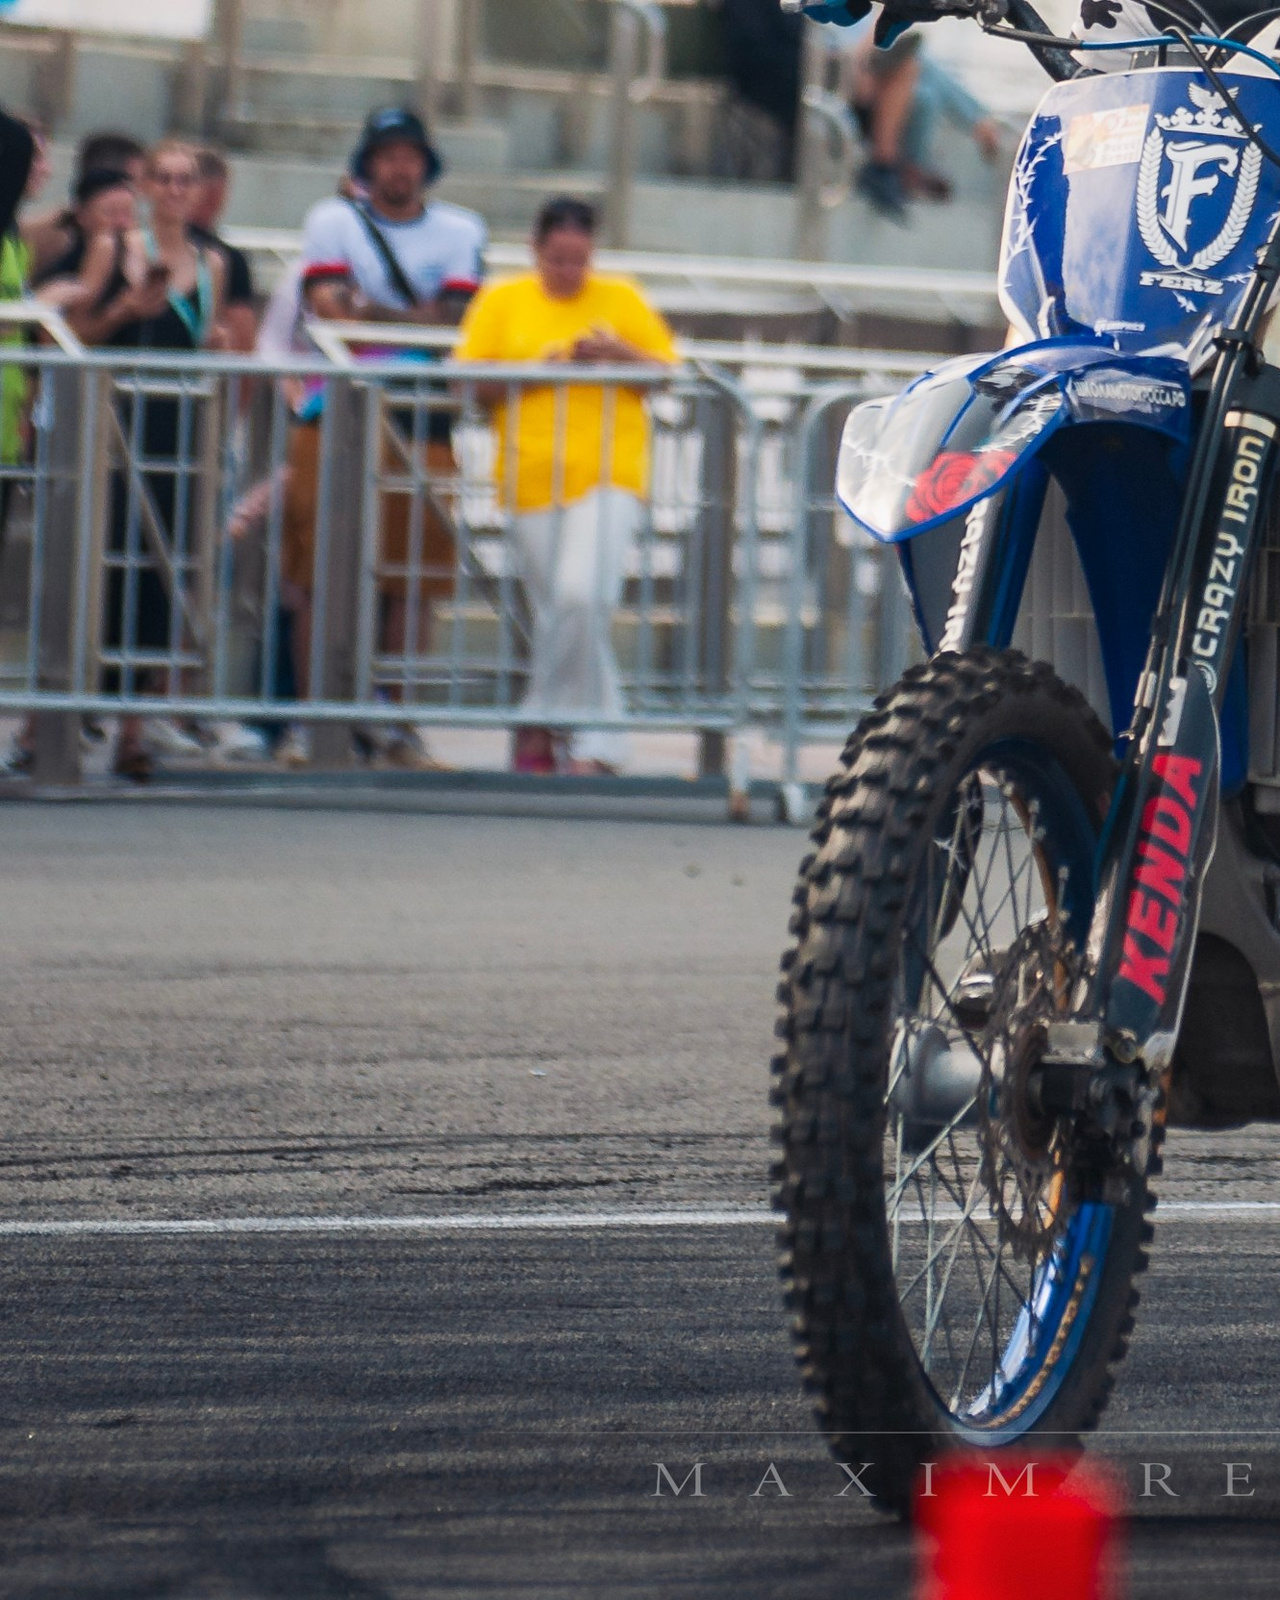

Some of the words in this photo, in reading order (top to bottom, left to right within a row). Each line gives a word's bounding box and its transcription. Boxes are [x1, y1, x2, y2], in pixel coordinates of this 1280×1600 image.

[1139, 271, 1224, 295] FERZ
[1192, 531, 1245, 658] CRAZY
[1222, 434, 1265, 524] IRON
[1118, 753, 1203, 1007] KENDA
